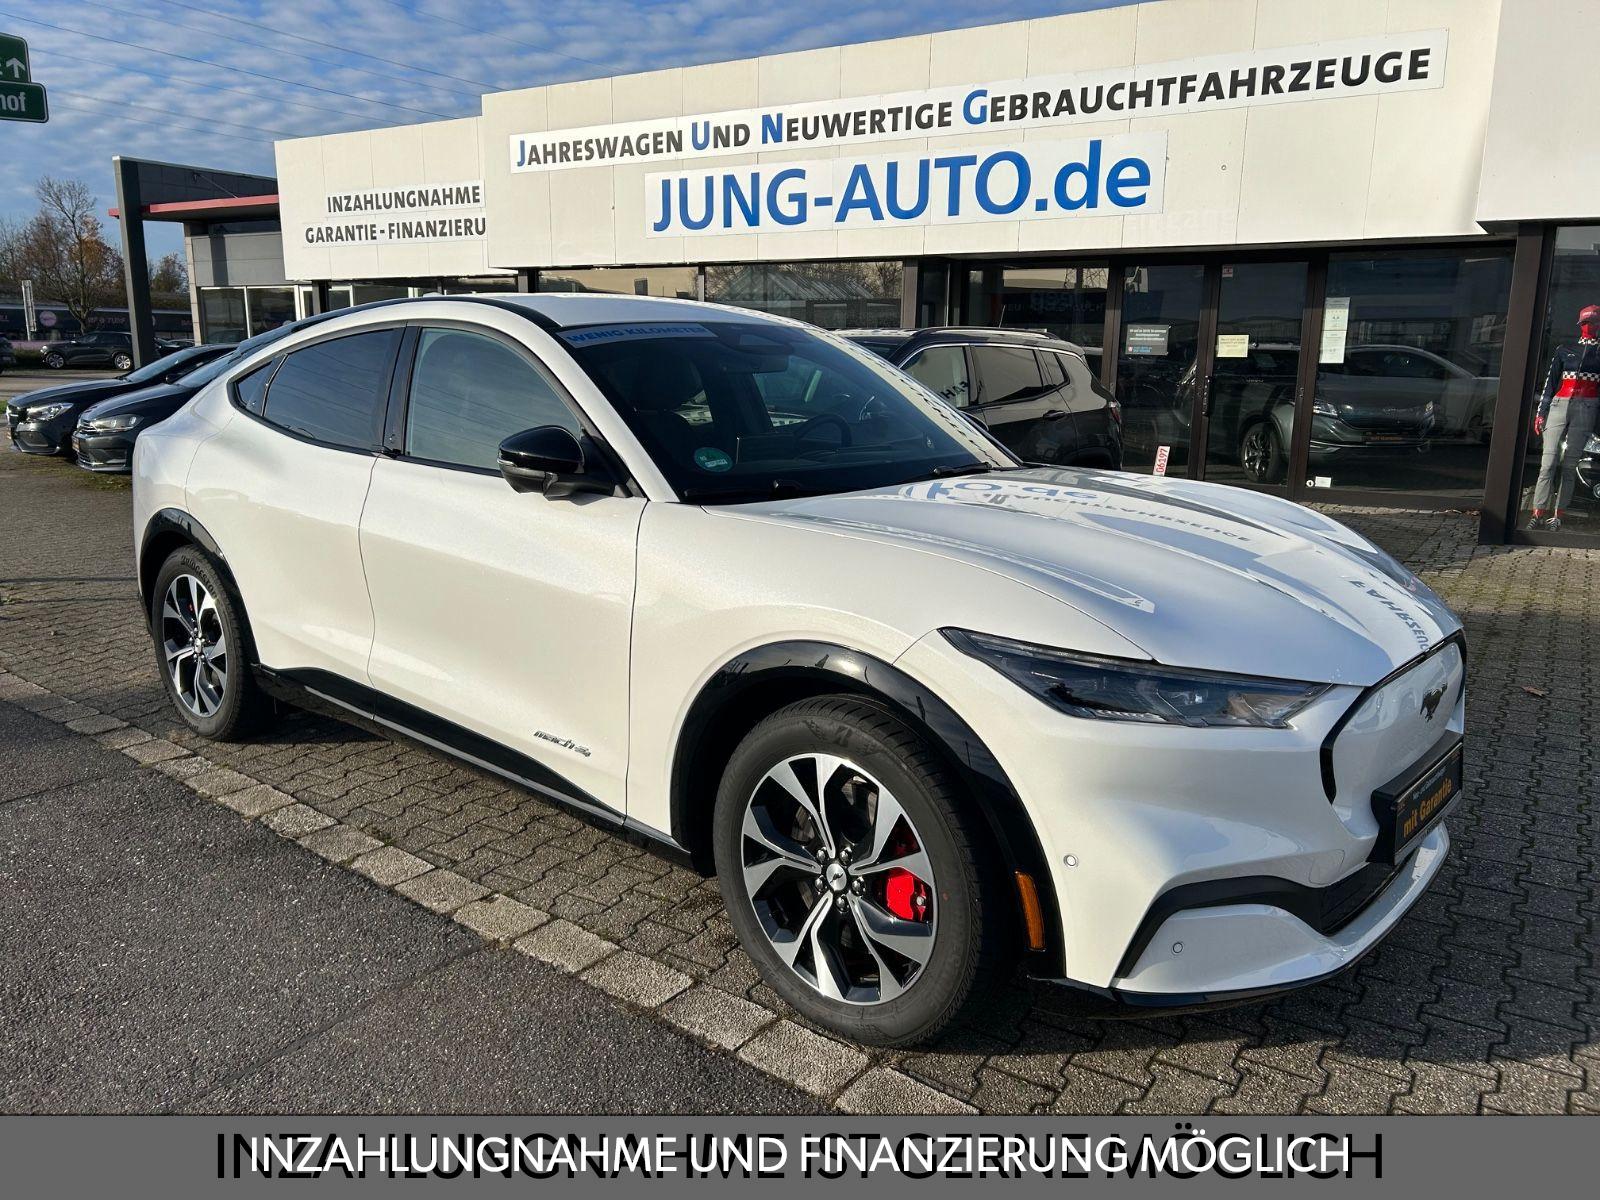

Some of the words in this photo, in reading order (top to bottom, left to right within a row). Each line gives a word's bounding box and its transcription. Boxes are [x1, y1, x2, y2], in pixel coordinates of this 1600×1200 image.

[517, 130, 683, 167] JAHRESWAGEN
[691, 121, 751, 151] UND
[761, 102, 953, 145] NEUWERTIGE
[962, 48, 1431, 126] GEBRAUCHTFAHRZEUGE
[327, 185, 481, 213] INZAHLUNGNAHME
[653, 138, 1151, 232] JUNG-AUTO.de
[567, 329, 624, 342] WENIG
[1403, 809, 1418, 838] mit
[1420, 778, 1452, 821] Garantie
